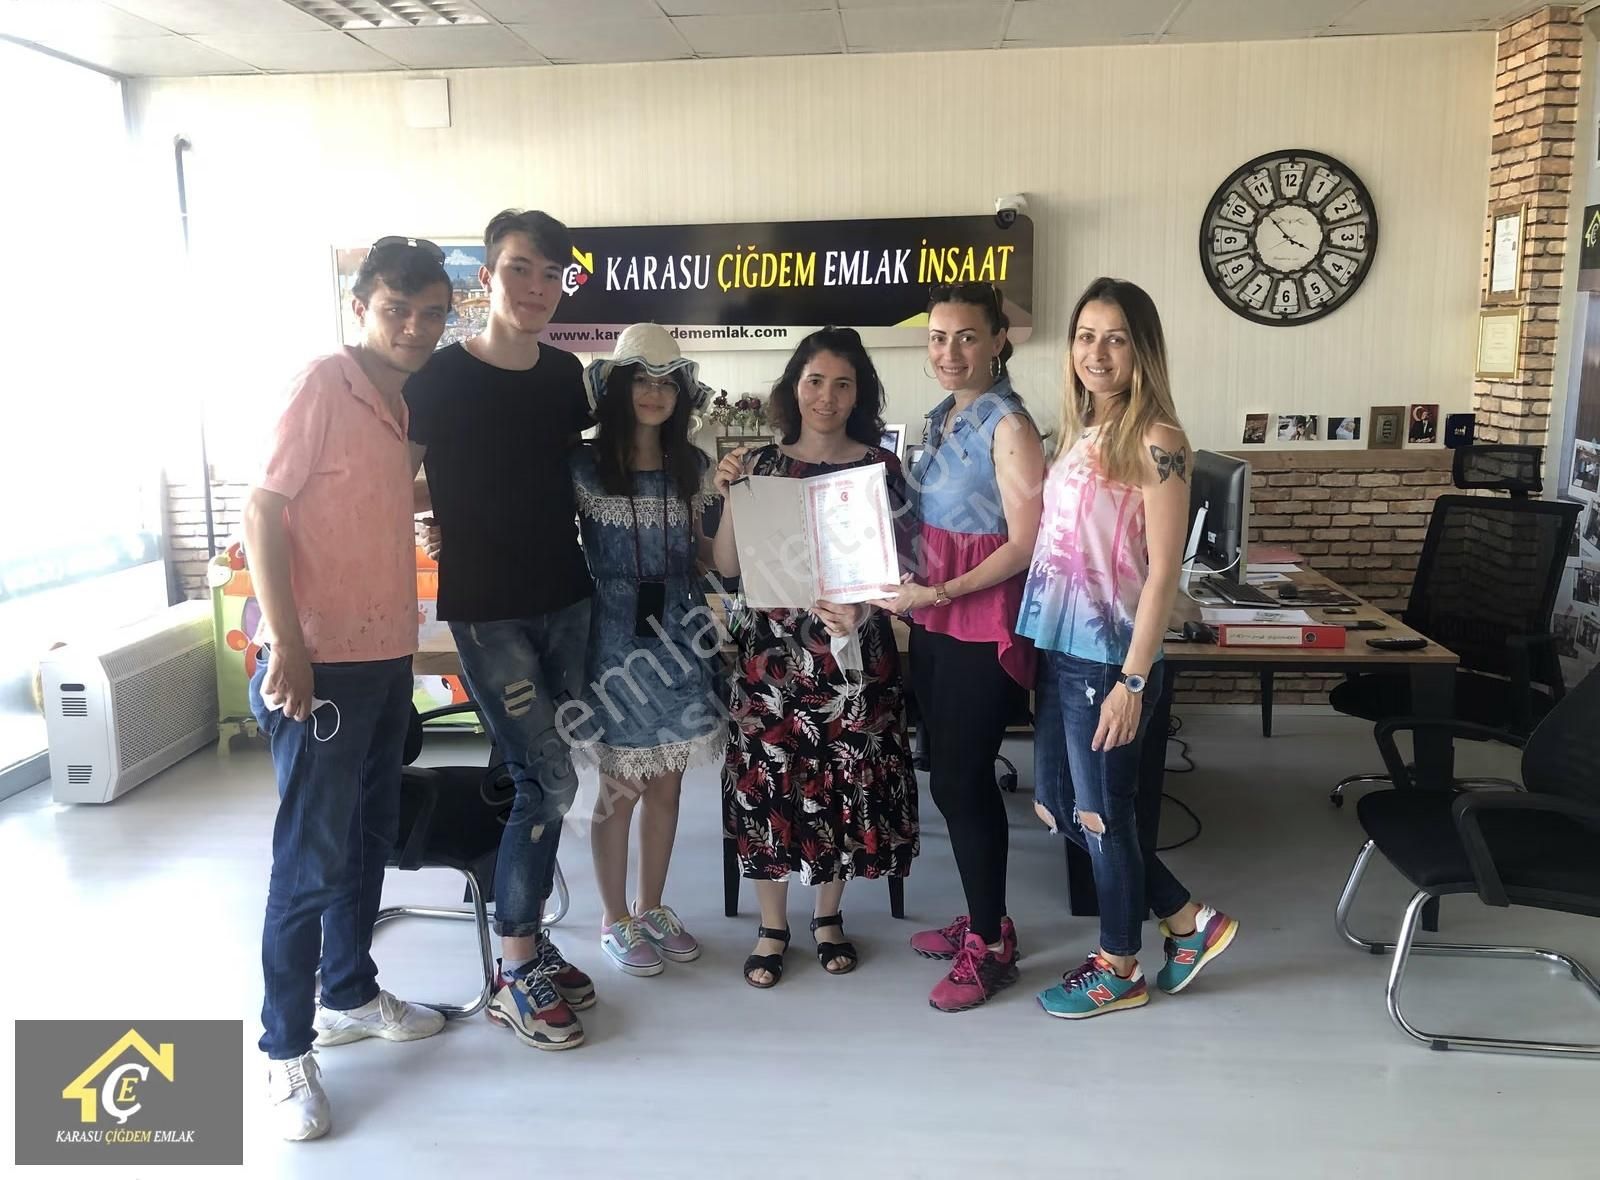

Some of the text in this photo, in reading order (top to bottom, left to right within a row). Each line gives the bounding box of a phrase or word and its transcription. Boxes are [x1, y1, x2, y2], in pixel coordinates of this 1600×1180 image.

[1284, 174, 1298, 188] 12
[1316, 181, 1326, 194] 1
[1254, 182, 1270, 197] 11
[1232, 204, 1247, 218] 10
[1334, 203, 1348, 214] 2
[1224, 236, 1238, 245] 9
[1341, 233, 1355, 243] 3
[606, 254, 711, 291] KARASU
[717, 244, 816, 293] ÇİĞDEM
[823, 248, 912, 287] EMLAK
[1231, 263, 1245, 275] 8
[1331, 262, 1344, 273] 4
[1251, 284, 1263, 296] 7
[1310, 282, 1321, 295] 5
[1282, 290, 1290, 303] 6
[1174, 947, 1198, 965] N
[1087, 982, 1115, 1007] N
